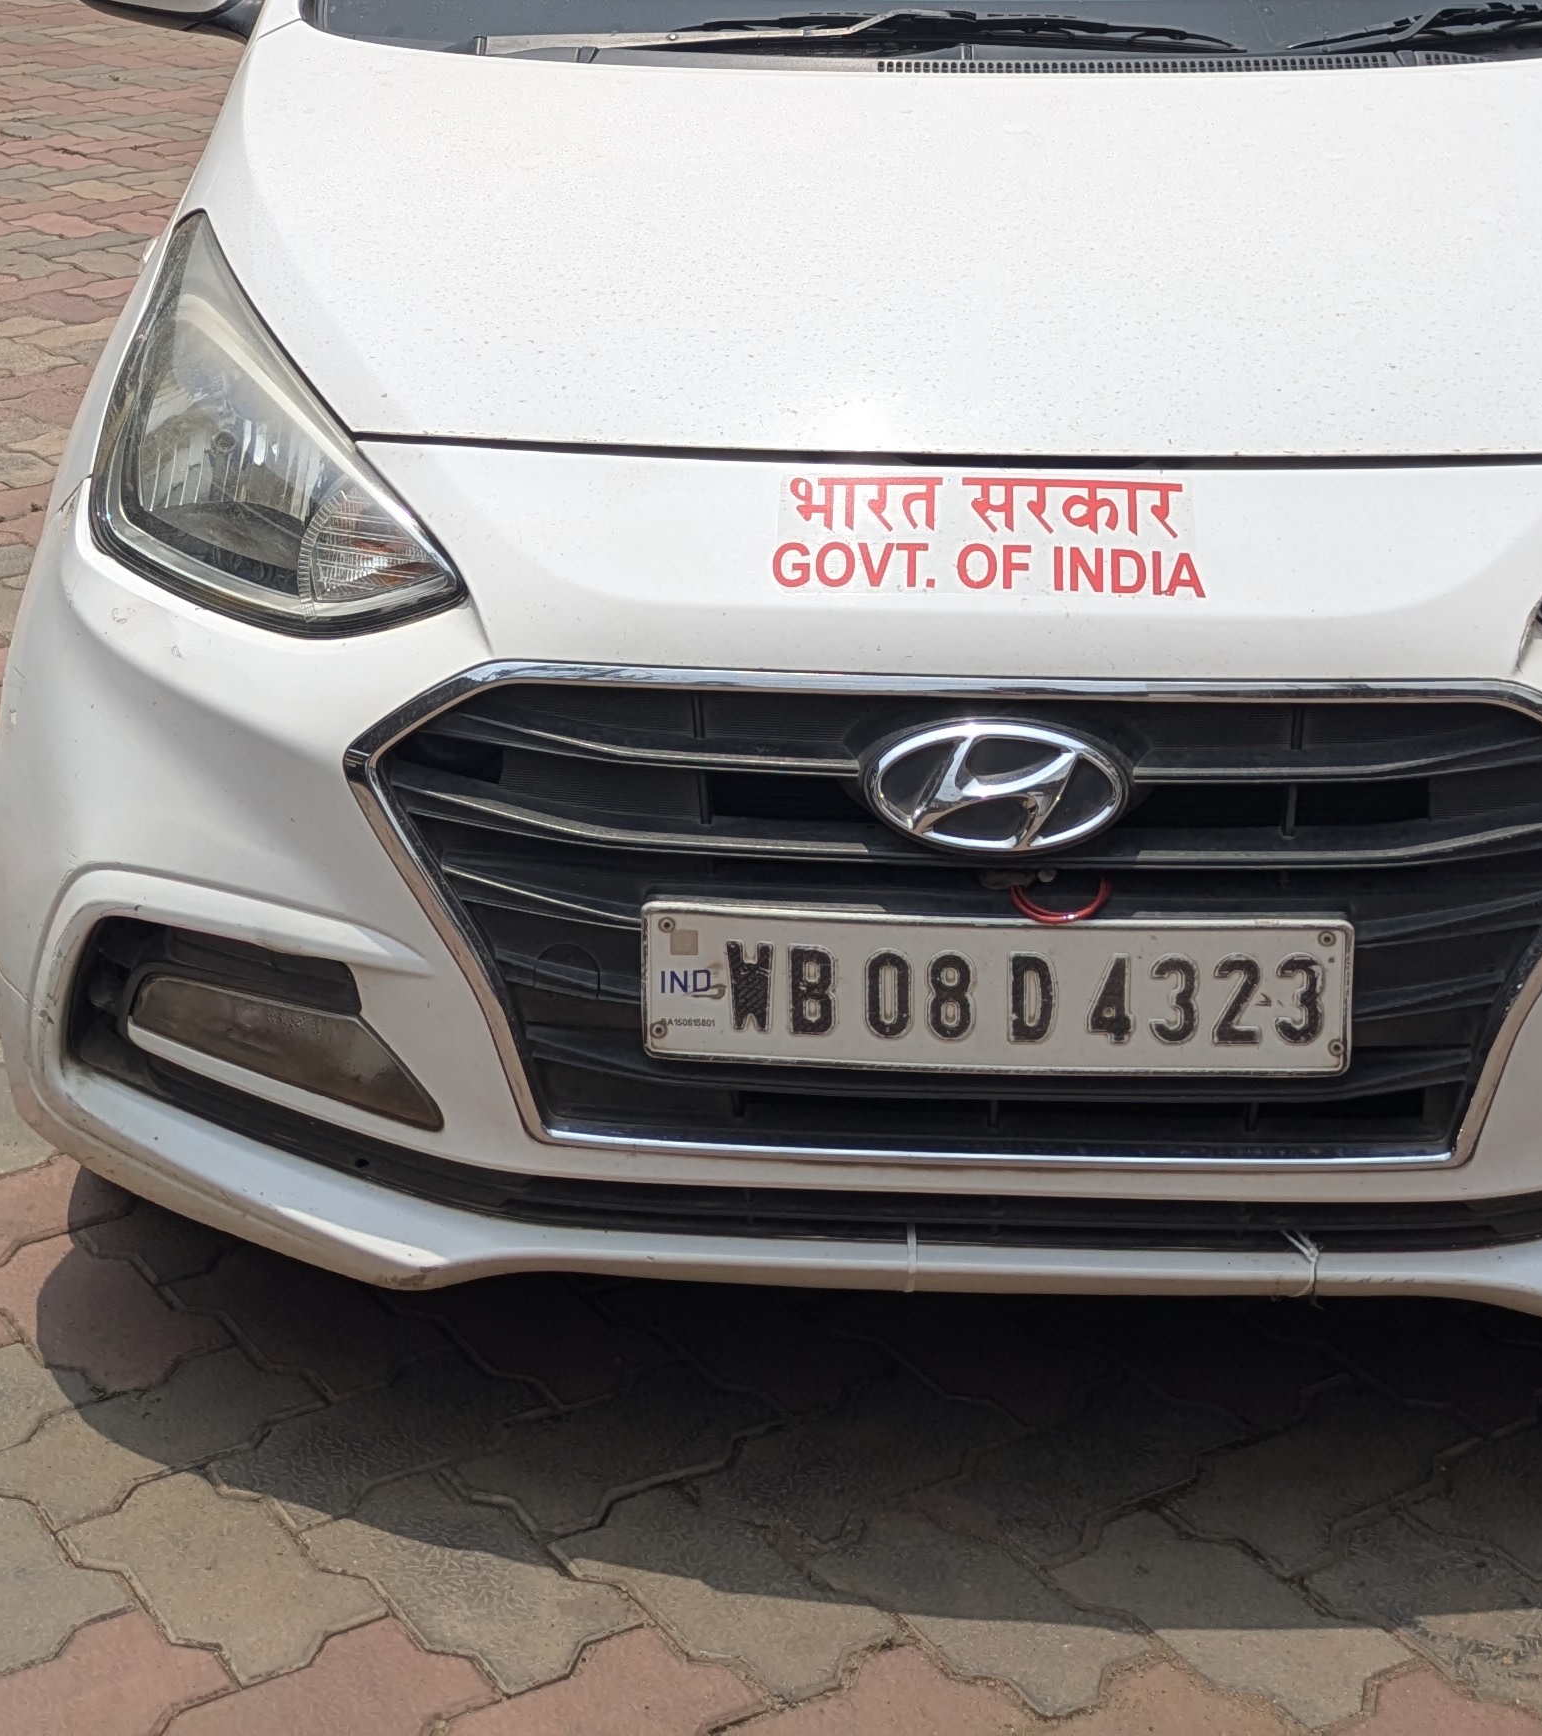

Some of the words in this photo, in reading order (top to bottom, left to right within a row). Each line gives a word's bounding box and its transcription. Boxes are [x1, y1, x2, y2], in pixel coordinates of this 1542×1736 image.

[789, 475, 944, 533] भारत
[961, 477, 1185, 540] सरकार
[771, 541, 937, 590] GOVT.
[956, 542, 1030, 590] OF
[1053, 545, 1207, 599] INDIA
[660, 969, 711, 994] IND
[725, 939, 838, 1037] WB
[864, 948, 977, 1041] 08
[1007, 952, 1059, 1043] D
[1085, 952, 1326, 1047] 4323
